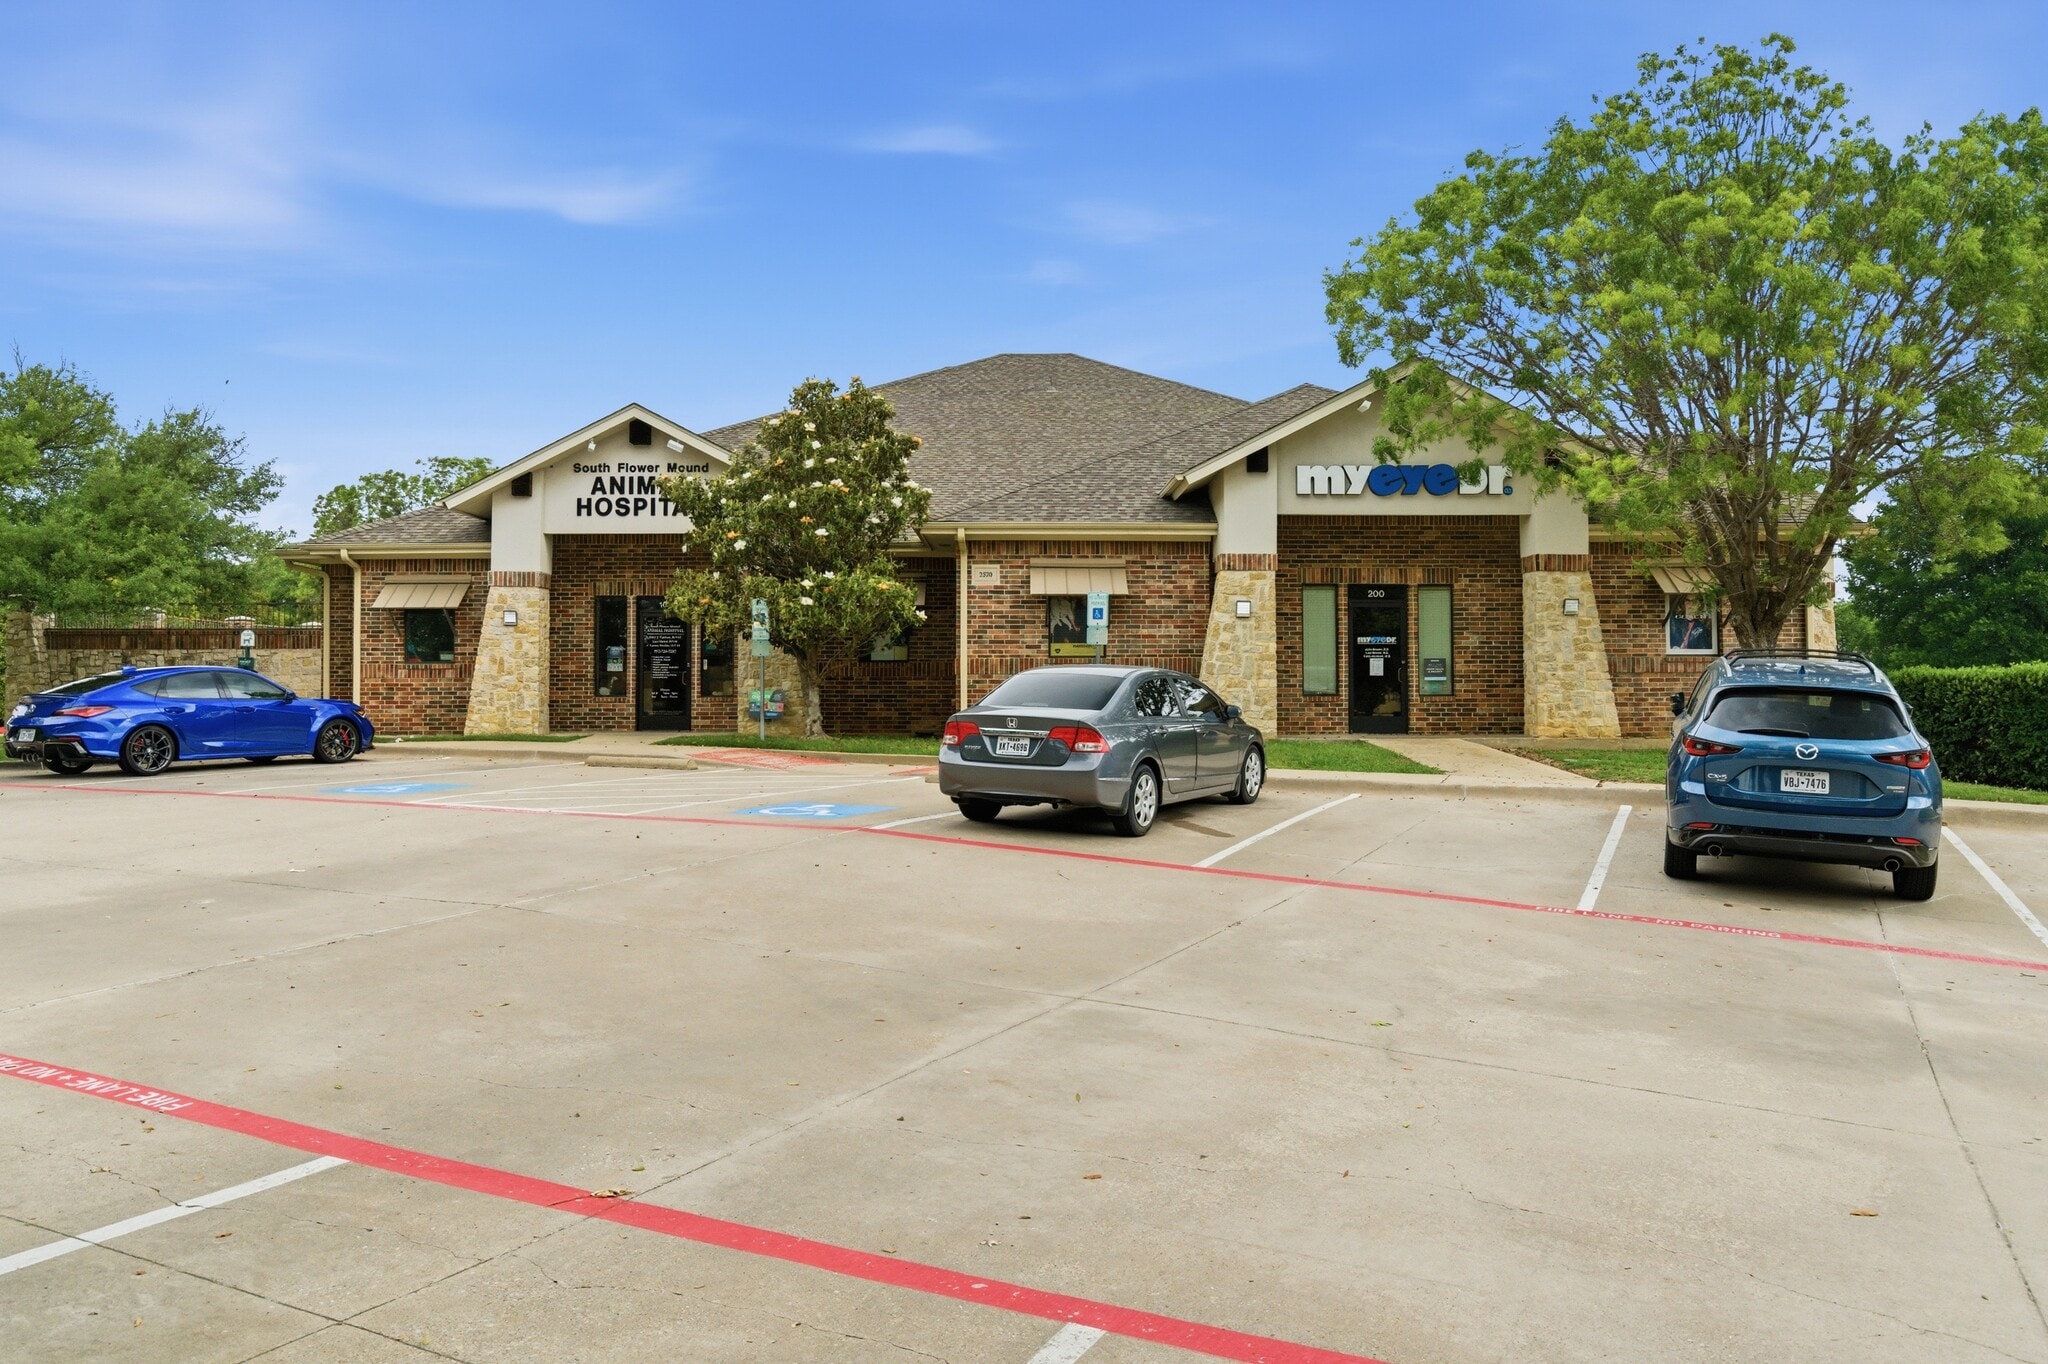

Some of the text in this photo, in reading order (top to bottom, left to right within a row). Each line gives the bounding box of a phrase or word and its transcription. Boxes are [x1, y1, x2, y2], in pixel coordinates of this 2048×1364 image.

[573, 463, 709, 473] South Flower Mound
[591, 476, 663, 495] ANIM
[576, 497, 688, 517] HOSPITA
[1367, 589, 1385, 598] 200
[1783, 776, 1827, 790] VBJ-7476
[1536, 906, 1782, 938] FIRE LANE NO PARKING
[17, 1063, 65, 1079] NO
[65, 1077, 140, 1098] LANE
[126, 1091, 194, 1111] FIRE
